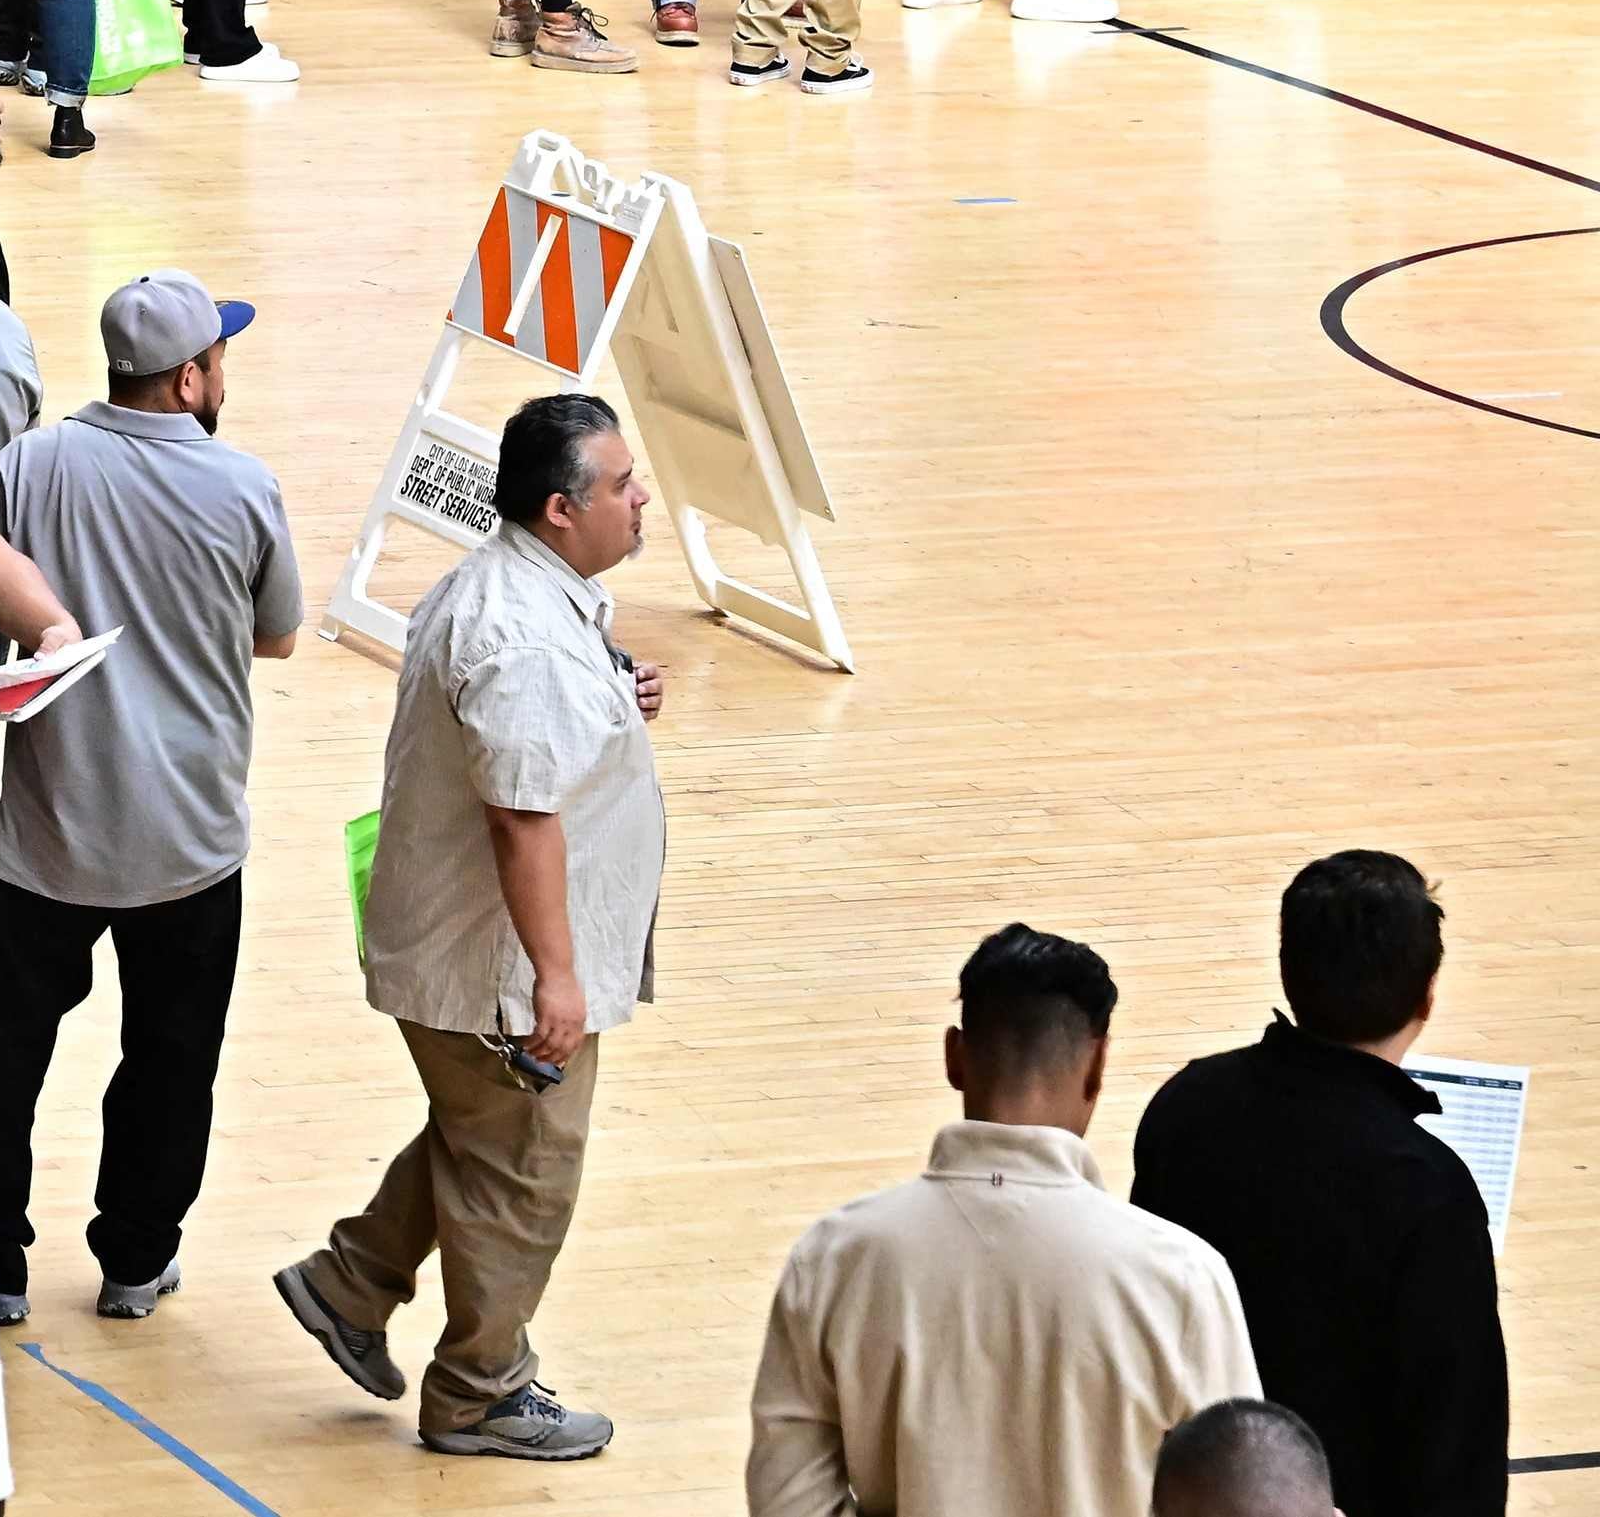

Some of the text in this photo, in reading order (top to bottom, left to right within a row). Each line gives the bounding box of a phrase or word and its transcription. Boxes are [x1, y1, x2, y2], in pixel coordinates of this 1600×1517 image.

[411, 455, 435, 479] DEPT.
[434, 465, 448, 483] OF
[445, 470, 476, 496] PUBLIC
[429, 443, 446, 461] CITY
[444, 451, 456, 465] OF
[454, 454, 470, 472] LOS
[400, 474, 497, 533] STREET SERVICES
